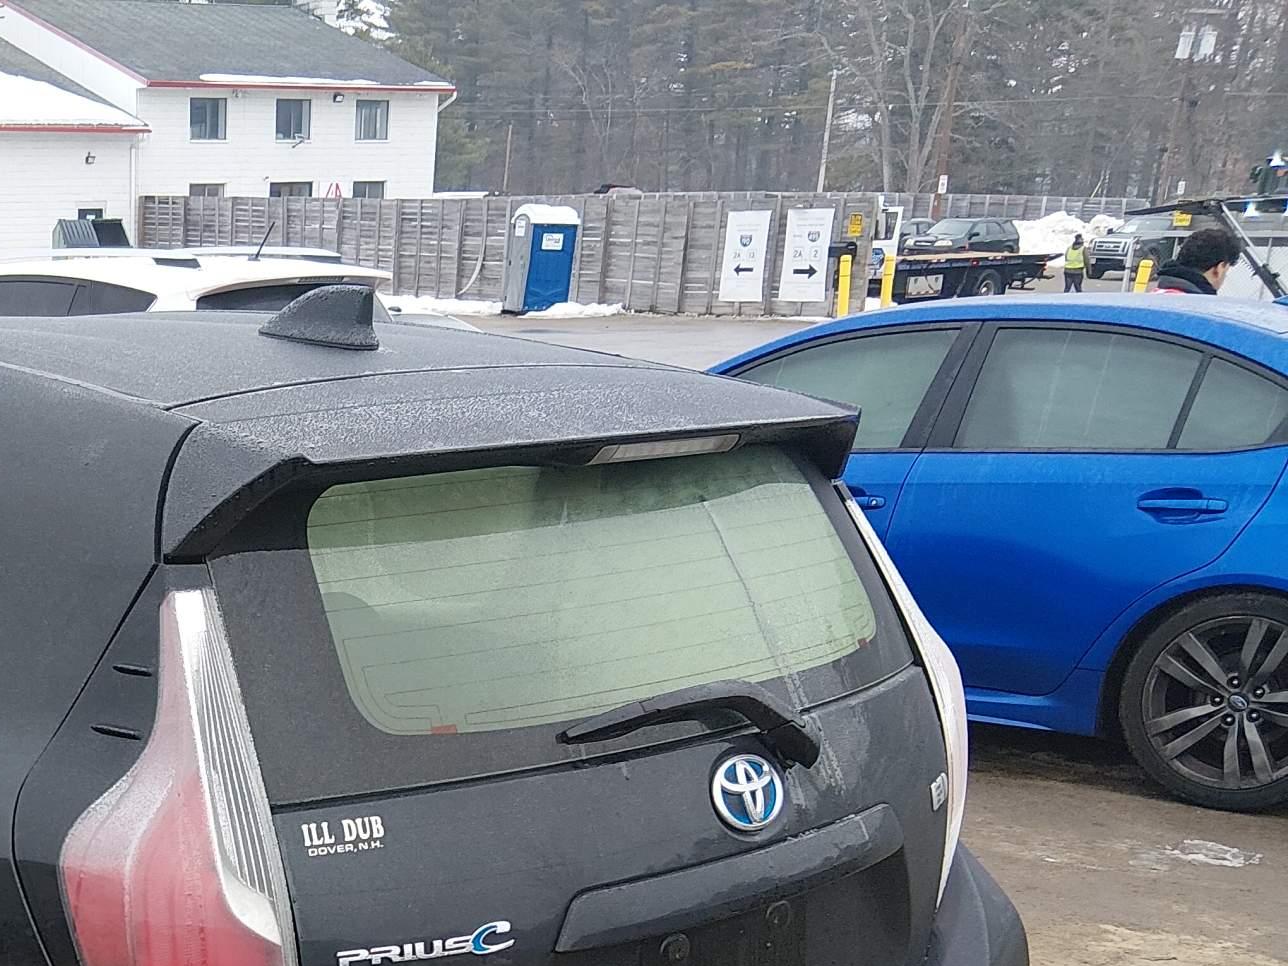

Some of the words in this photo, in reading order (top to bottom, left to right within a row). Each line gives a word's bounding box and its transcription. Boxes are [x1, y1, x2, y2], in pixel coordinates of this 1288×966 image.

[301, 821, 335, 847] ILL
[341, 815, 385, 842] DUB
[308, 843, 358, 857] DOVER,
